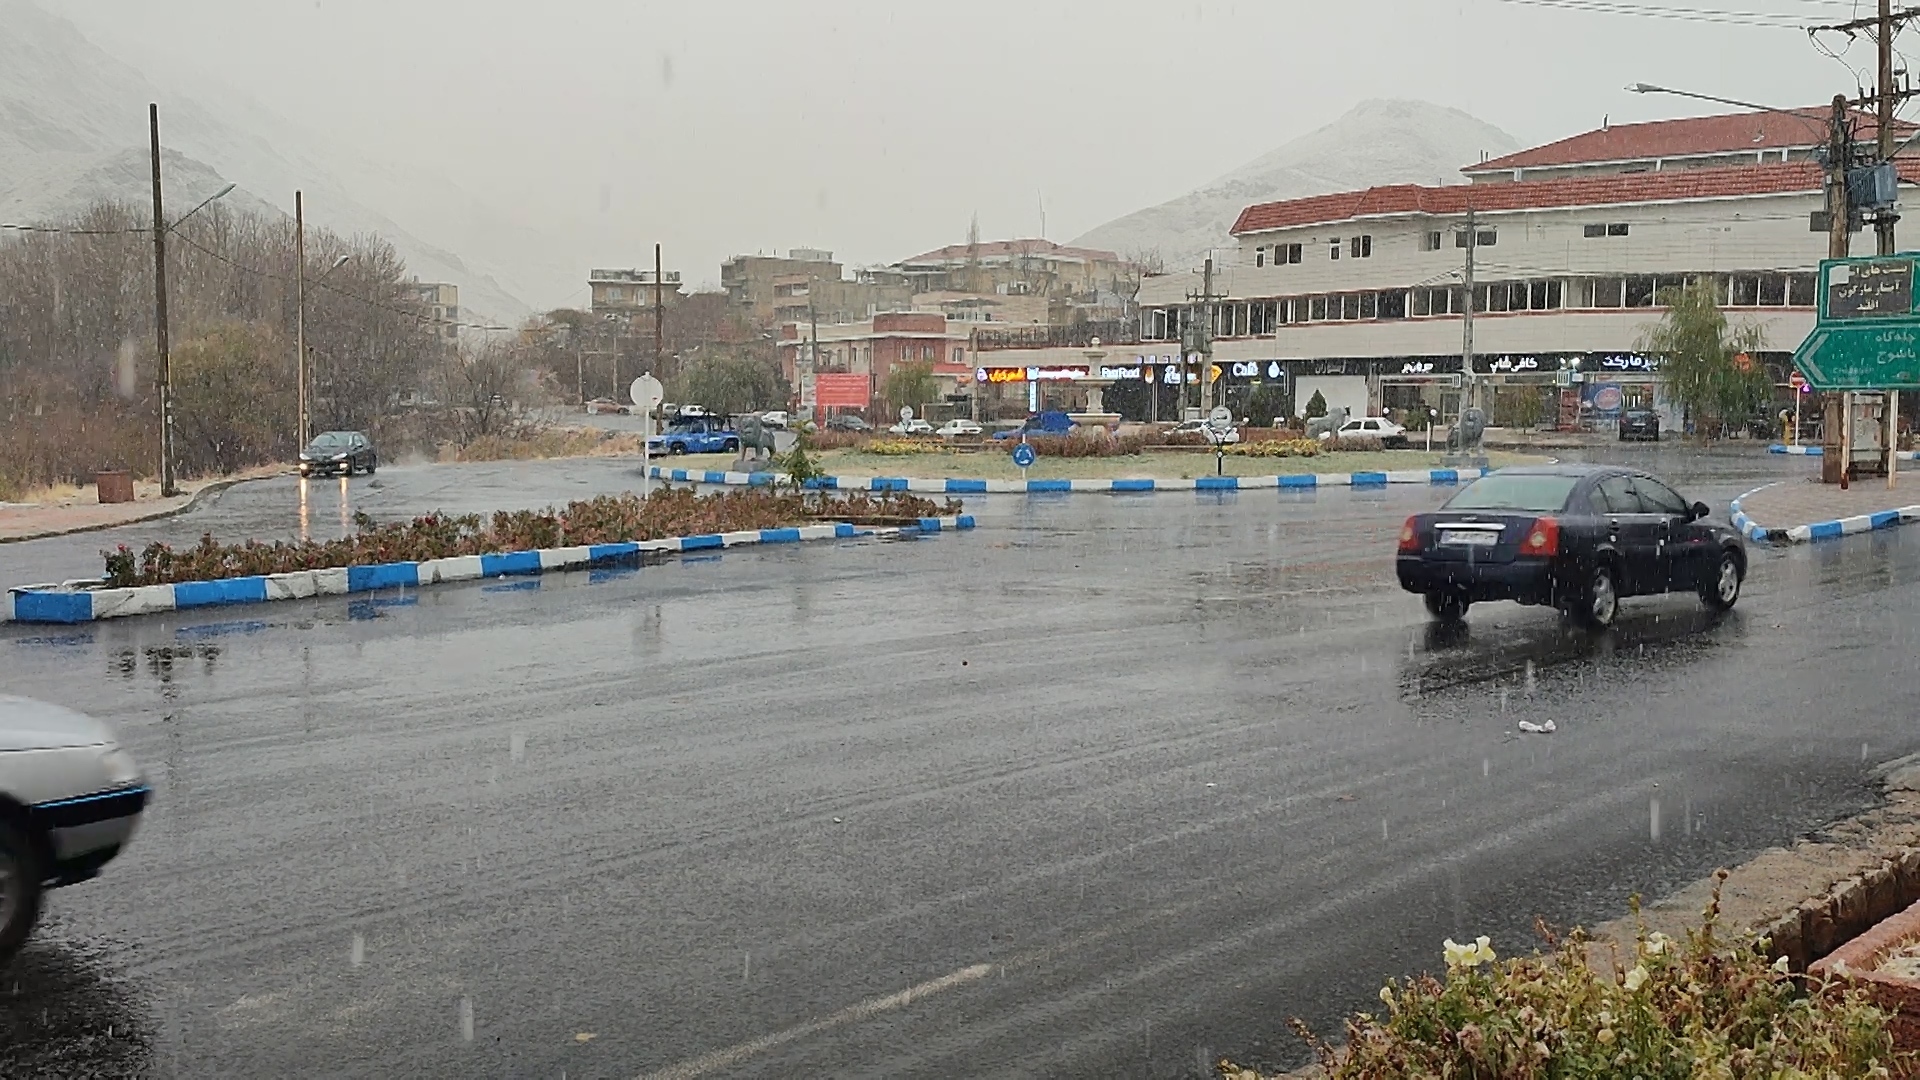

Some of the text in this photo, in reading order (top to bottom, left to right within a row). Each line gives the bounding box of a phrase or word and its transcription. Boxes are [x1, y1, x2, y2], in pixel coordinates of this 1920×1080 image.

[1875, 279, 1903, 296] آبشار
[1489, 354, 1539, 375] کافی شاپ
